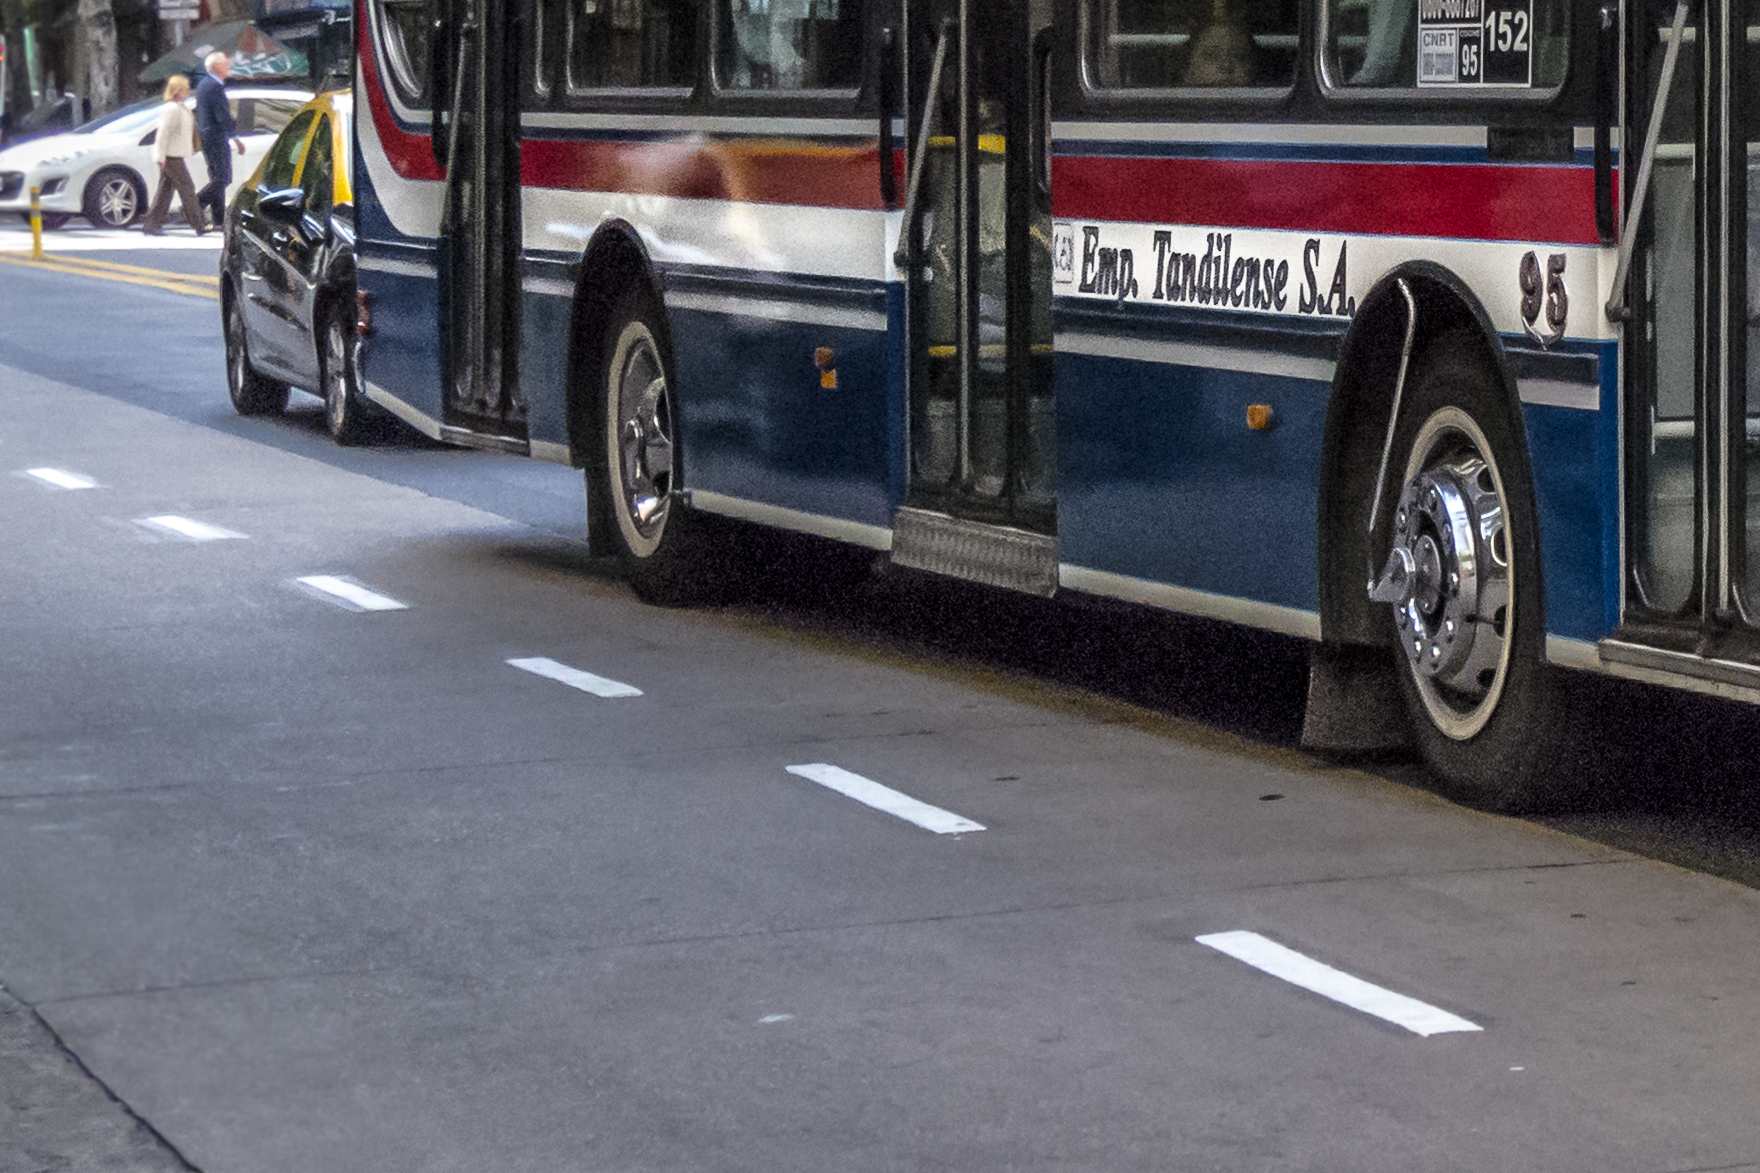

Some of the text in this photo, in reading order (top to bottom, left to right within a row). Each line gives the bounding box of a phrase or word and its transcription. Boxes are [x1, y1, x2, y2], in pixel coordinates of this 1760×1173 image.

[1423, 32, 1455, 48] CNRT
[1485, 9, 1529, 53] 152
[1461, 43, 1478, 76] 95
[1078, 225, 1139, 301] Emp.
[1153, 230, 1288, 312] Tandilense
[1299, 239, 1356, 317] S.A.
[1518, 250, 1568, 335] 95
